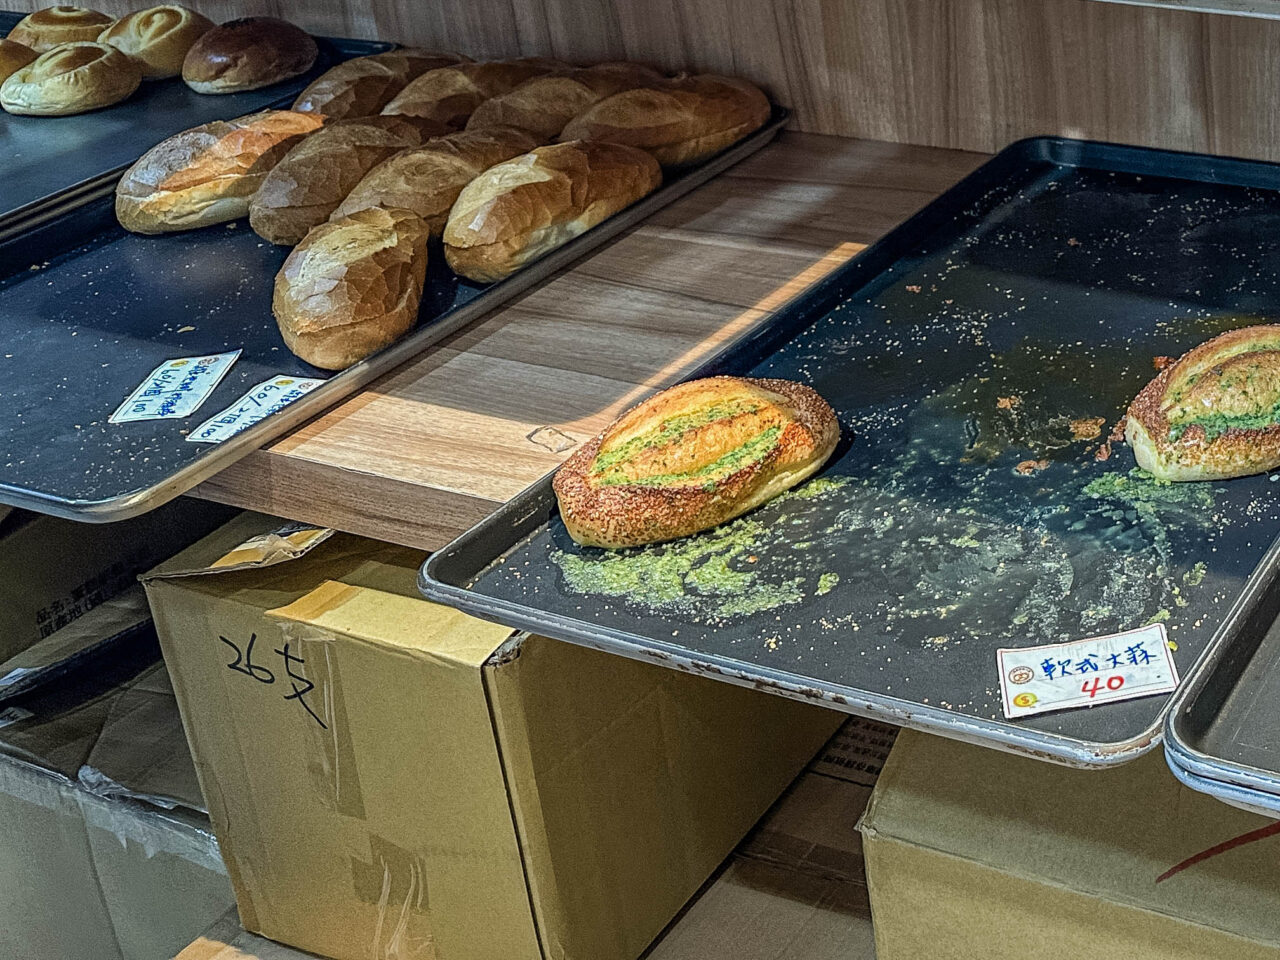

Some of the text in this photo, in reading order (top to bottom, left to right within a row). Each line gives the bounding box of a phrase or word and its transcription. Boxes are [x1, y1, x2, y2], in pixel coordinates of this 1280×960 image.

[1040, 641, 1158, 681] 軟式大蒜
[1081, 675, 1125, 698] 40
